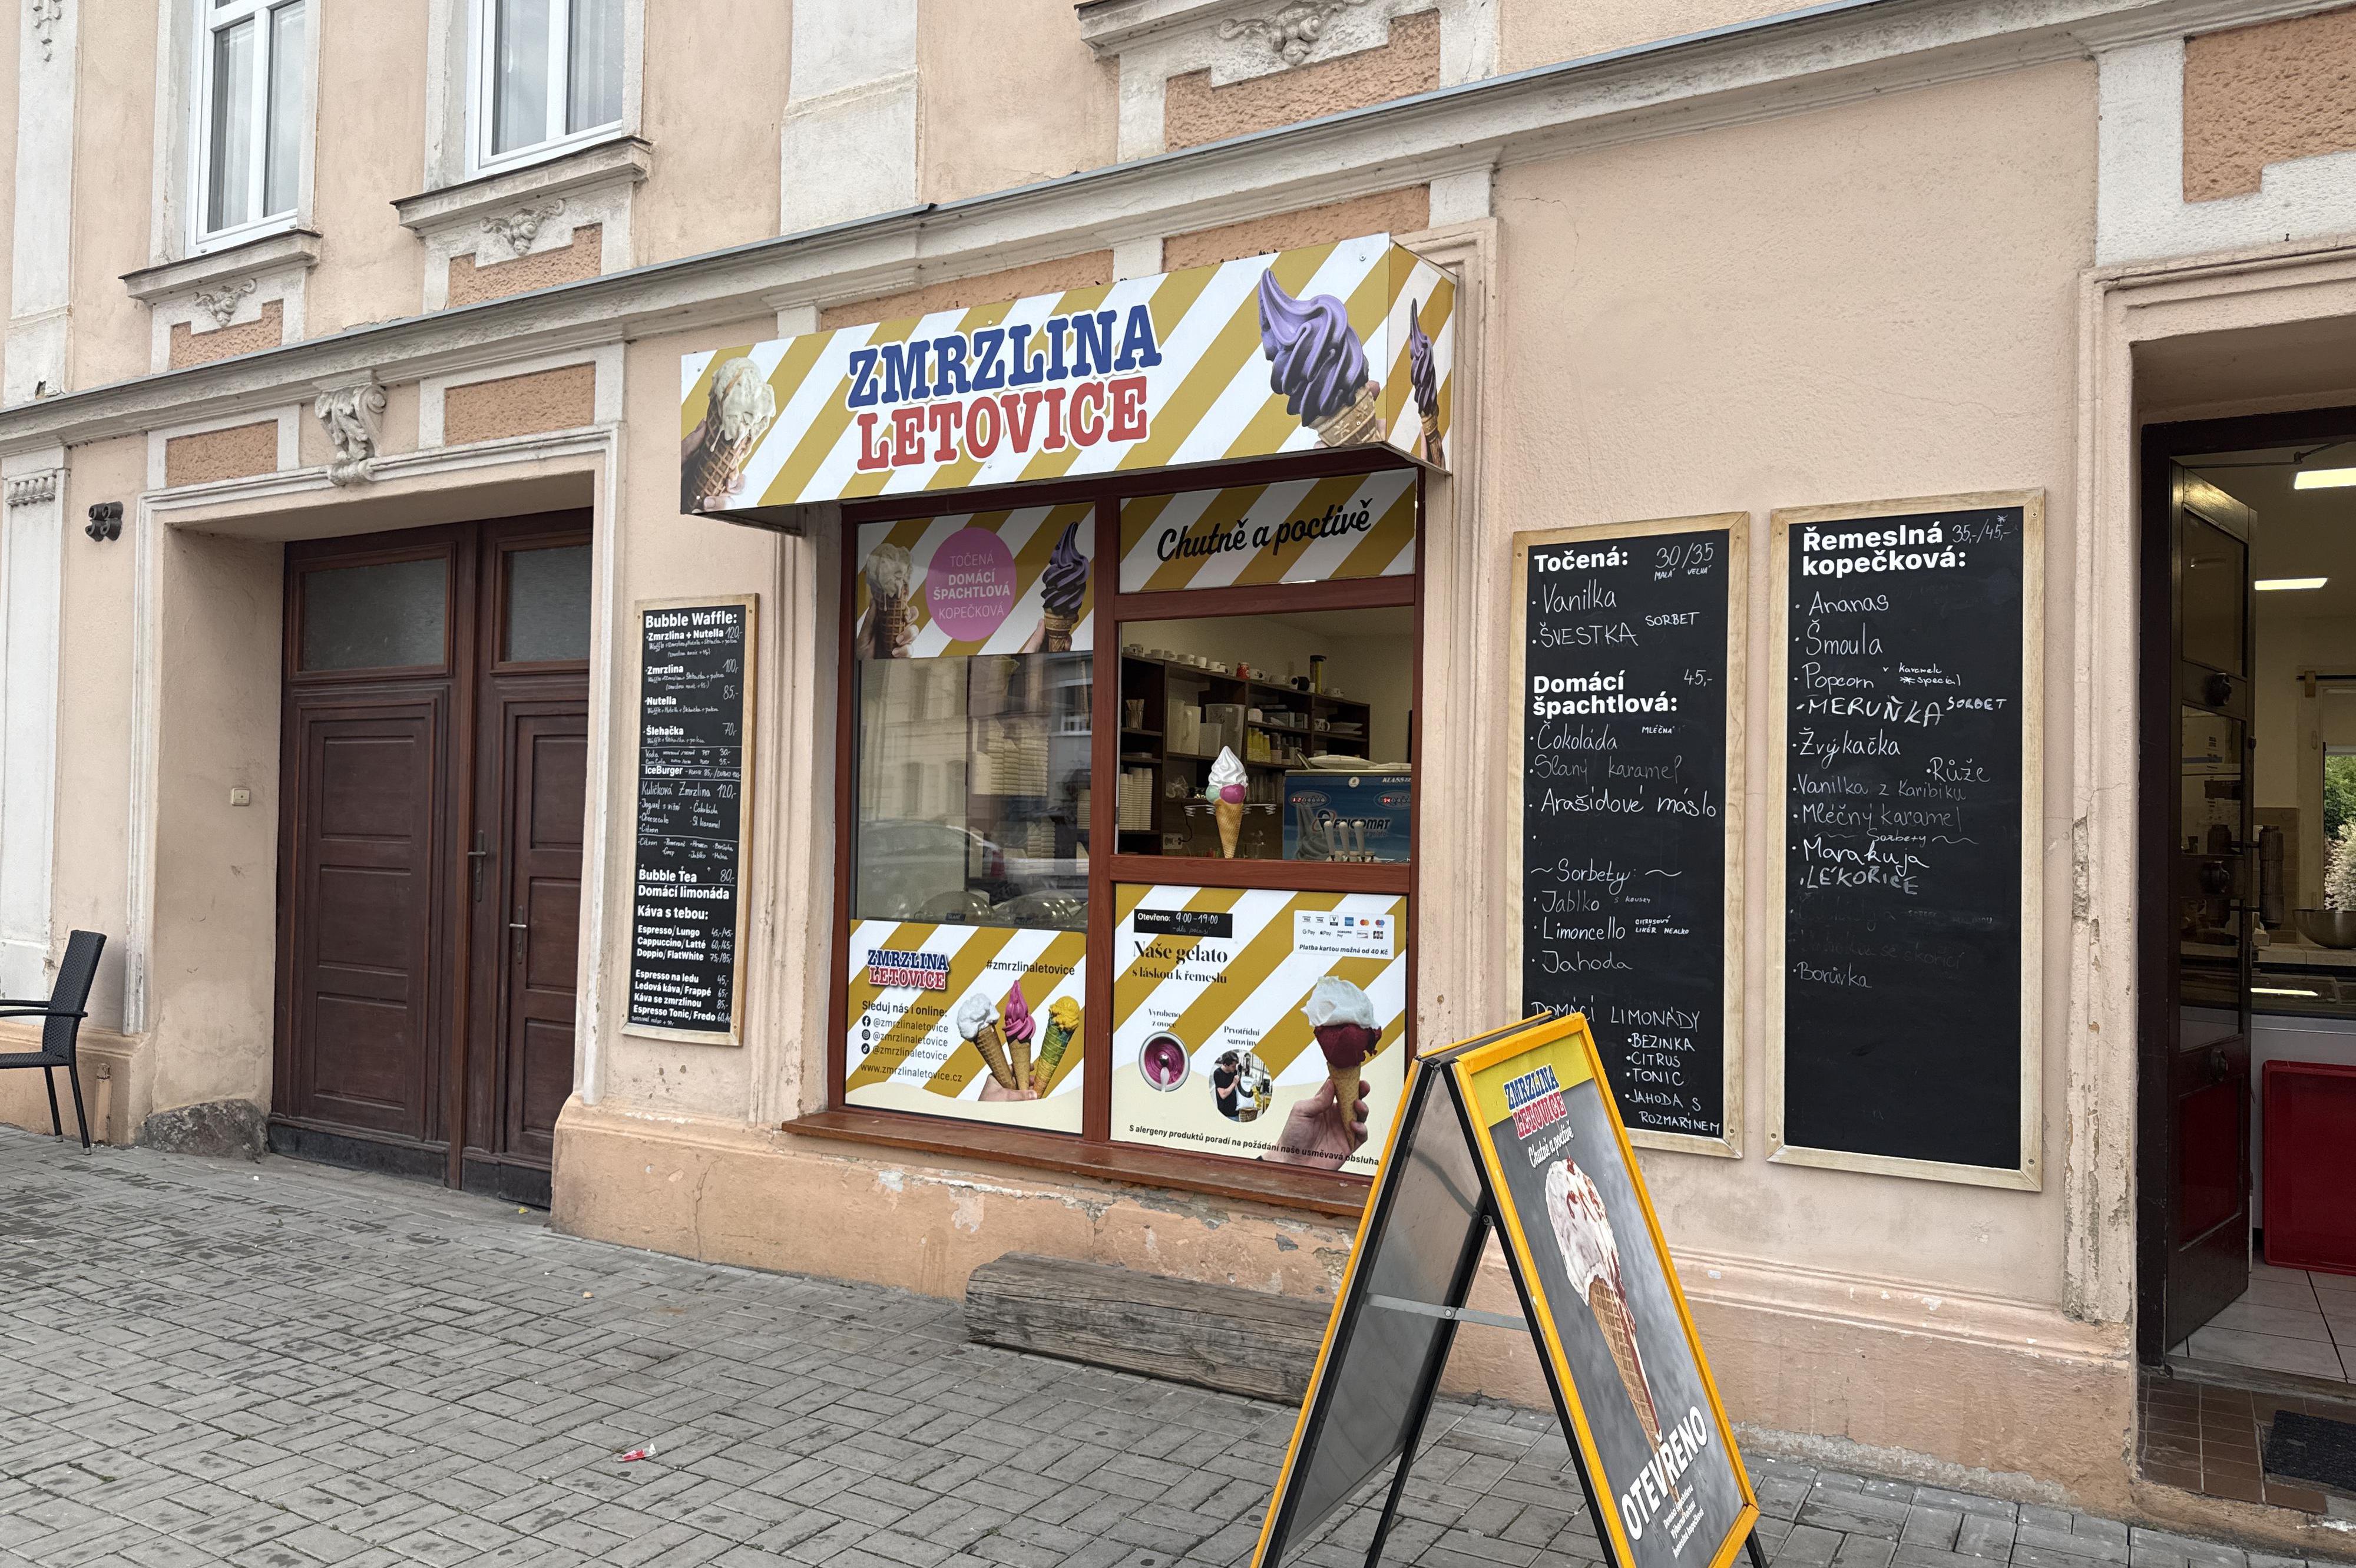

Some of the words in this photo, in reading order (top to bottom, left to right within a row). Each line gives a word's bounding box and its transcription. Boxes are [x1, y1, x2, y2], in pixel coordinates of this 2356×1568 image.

[848, 305, 1162, 408] ZMRZLINA
[857, 376, 1147, 471] LETOVICE
[1157, 518, 1249, 561] Chutně
[1252, 527, 1270, 548] a
[1273, 498, 1372, 556] poctivě
[1803, 521, 1943, 552] Řemeslná
[949, 550, 994, 567] TOČENÁ
[1534, 546, 1628, 572] Točená:
[1803, 546, 1965, 578] kopečková:
[948, 568, 995, 585] DOMÁCÍ
[1654, 568, 1676, 581] MALÁ
[934, 581, 1010, 600] ŠPACHTLOVÁ
[1544, 579, 1616, 613] Vanilka
[939, 601, 1004, 619] KOPEČKOVÁ
[1809, 591, 1889, 616] Ananas
[646, 613, 689, 628] Bubble
[692, 611, 737, 625] Waffle:
[648, 631, 684, 641] Zmrzlina
[693, 628, 723, 639] Nutella
[1540, 622, 1638, 647] ŠVESTKA
[1646, 611, 1700, 626] SORBET
[1806, 620, 1882, 656] Šmoula
[647, 664, 683, 674] Zmrzlina
[1534, 670, 1625, 693] Domácí
[1802, 662, 1874, 695] Popcorn
[647, 696, 676, 705] Nutella
[1533, 691, 1677, 719] špachtlová:
[1946, 696, 2007, 710] SORBET
[646, 725, 684, 735] Šlehačka
[1537, 720, 1617, 750] Čokoláda
[1799, 727, 1901, 769] Žvýkačka
[645, 766, 683, 776] IceBurger
[1534, 754, 1587, 785] Slaný
[1609, 755, 1682, 784] karamel
[1930, 757, 1991, 782] Růže
[641, 781, 673, 795] Kuličková
[679, 782, 711, 796] Zmrzlina
[1797, 774, 1868, 795] Vanilka
[1898, 779, 1966, 800] Karibiku
[1541, 785, 1644, 815] Arašídové
[1657, 788, 1716, 816] máslo
[641, 812, 669, 824] Cheesecake
[1802, 803, 1872, 829] Mléčný
[1881, 803, 1961, 832] karamel
[641, 824, 658, 833] Citron
[640, 838, 657, 846] Citron
[1803, 837, 1930, 877] Marakuja
[639, 869, 676, 882] Bubble
[679, 871, 697, 882] Tea
[638, 885, 678, 897] Domácí
[680, 886, 729, 899] limonáda
[1541, 890, 1600, 912] Jablko
[637, 905, 663, 917] Káva
[666, 908, 671, 917] s
[674, 907, 709, 920] tebou:
[1137, 913, 1170, 922] Otevřeno:
[677, 927, 700, 938] Lungo
[1543, 916, 1625, 940] Limoncello
[686, 940, 706, 949] Latté
[1134, 941, 1172, 960] Naše
[1176, 944, 1227, 965] gelato
[667, 950, 704, 961] FlatWhite
[868, 950, 948, 971] ZMRZLINA
[1541, 950, 1633, 973] Jahoda
[636, 970, 670, 981] Espresso
[682, 974, 699, 983] ledu
[986, 960, 1075, 975] #zmrzlinaletovice
[1140, 967, 1173, 979] láskou
[1176, 969, 1182, 980] k
[1184, 971, 1226, 984] řemeslu
[1799, 962, 1872, 988] Borůvka
[869, 967, 945, 988] LETOVICE
[635, 981, 661, 991] Ledová
[685, 986, 712, 997] Frappé
[634, 993, 651, 1003] Káva
[664, 997, 701, 1007] zmrzlinou
[862, 1000, 890, 1014] Sleduj
[893, 1003, 908, 1013] nás
[911, 1004, 913, 1014] i
[916, 1005, 947, 1017] online:
[633, 1005, 667, 1015] Espresso
[693, 1011, 716, 1021] Fredo
[1149, 1008, 1180, 1018] Vyrobeno
[1611, 1007, 1700, 1032] LIMONÁDY
[873, 1018, 948, 1033] @zmrzlinaletovice
[1224, 1026, 1260, 1036] Prvotřídní
[873, 1032, 948, 1046] @zmrzlinaletovice
[1227, 1038, 1257, 1047] suroviny
[1631, 1033, 1695, 1051] BEZINKA
[873, 1046, 947, 1060] @zmrzlinaletovice
[1631, 1053, 1680, 1068] CITRUS
[861, 1064, 962, 1081] www.zmrzlinaletovice.cz
[1632, 1069, 1684, 1086] TONIC
[1504, 1065, 1559, 1109] ZMRZLINA
[1629, 1089, 1683, 1108] JAHODA
[1692, 1097, 1701, 1111] S
[1513, 1091, 1567, 1137] LETOVICE
[1639, 1112, 1720, 1134] ROZMARÝNEM
[1136, 1126, 1167, 1137] alergeny
[1169, 1131, 1203, 1141] produktů
[1205, 1136, 1230, 1144] poradí
[1243, 1140, 1279, 1151] požádání
[1281, 1145, 1299, 1154] naše
[1302, 1149, 1343, 1160] usměvavá
[1345, 1155, 1379, 1166] obsluha
[1528, 1137, 1550, 1167] Chutně
[1553, 1120, 1574, 1156] poctivě
[1622, 1406, 1707, 1540] OTEVŘENO
